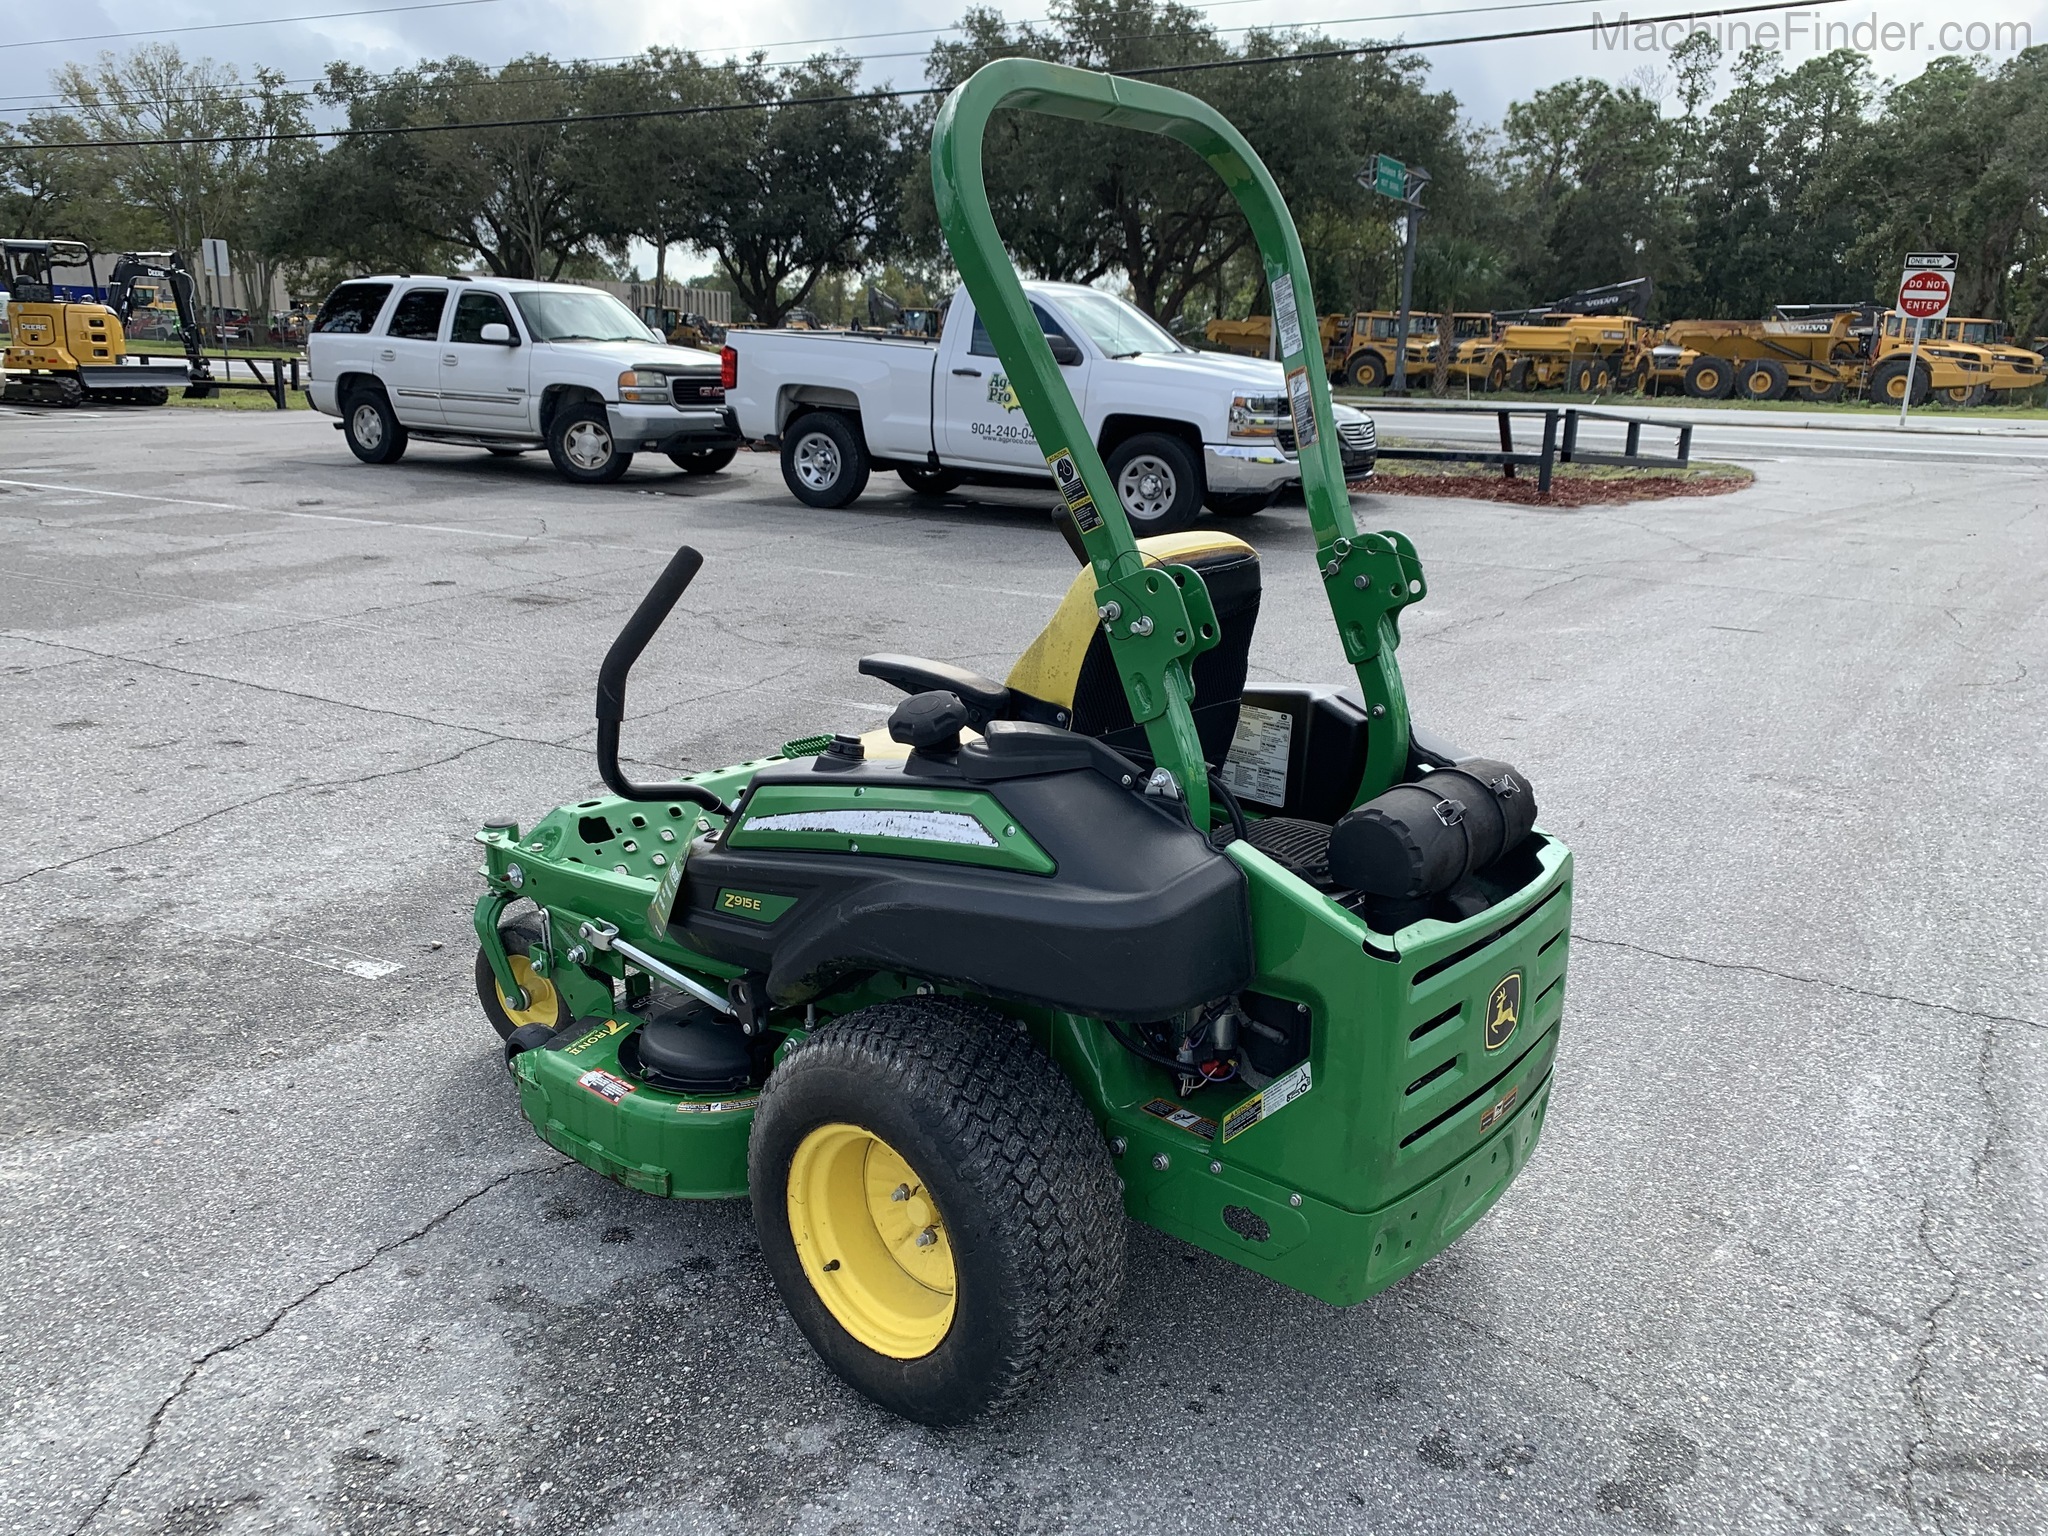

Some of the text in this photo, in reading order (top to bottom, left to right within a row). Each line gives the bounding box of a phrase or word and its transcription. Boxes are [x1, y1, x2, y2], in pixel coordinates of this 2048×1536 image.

[1910, 257, 1923, 265] ONE
[147, 268, 165, 277] DEERE
[1909, 280, 1947, 289] DO NOT
[1586, 296, 1619, 307] VOLVO
[1906, 300, 1940, 310] ENTER
[21, 323, 47, 331] DEERE
[1791, 324, 1828, 332] VOLVO
[988, 387, 1012, 403] Pro
[724, 893, 762, 911] Z915E
